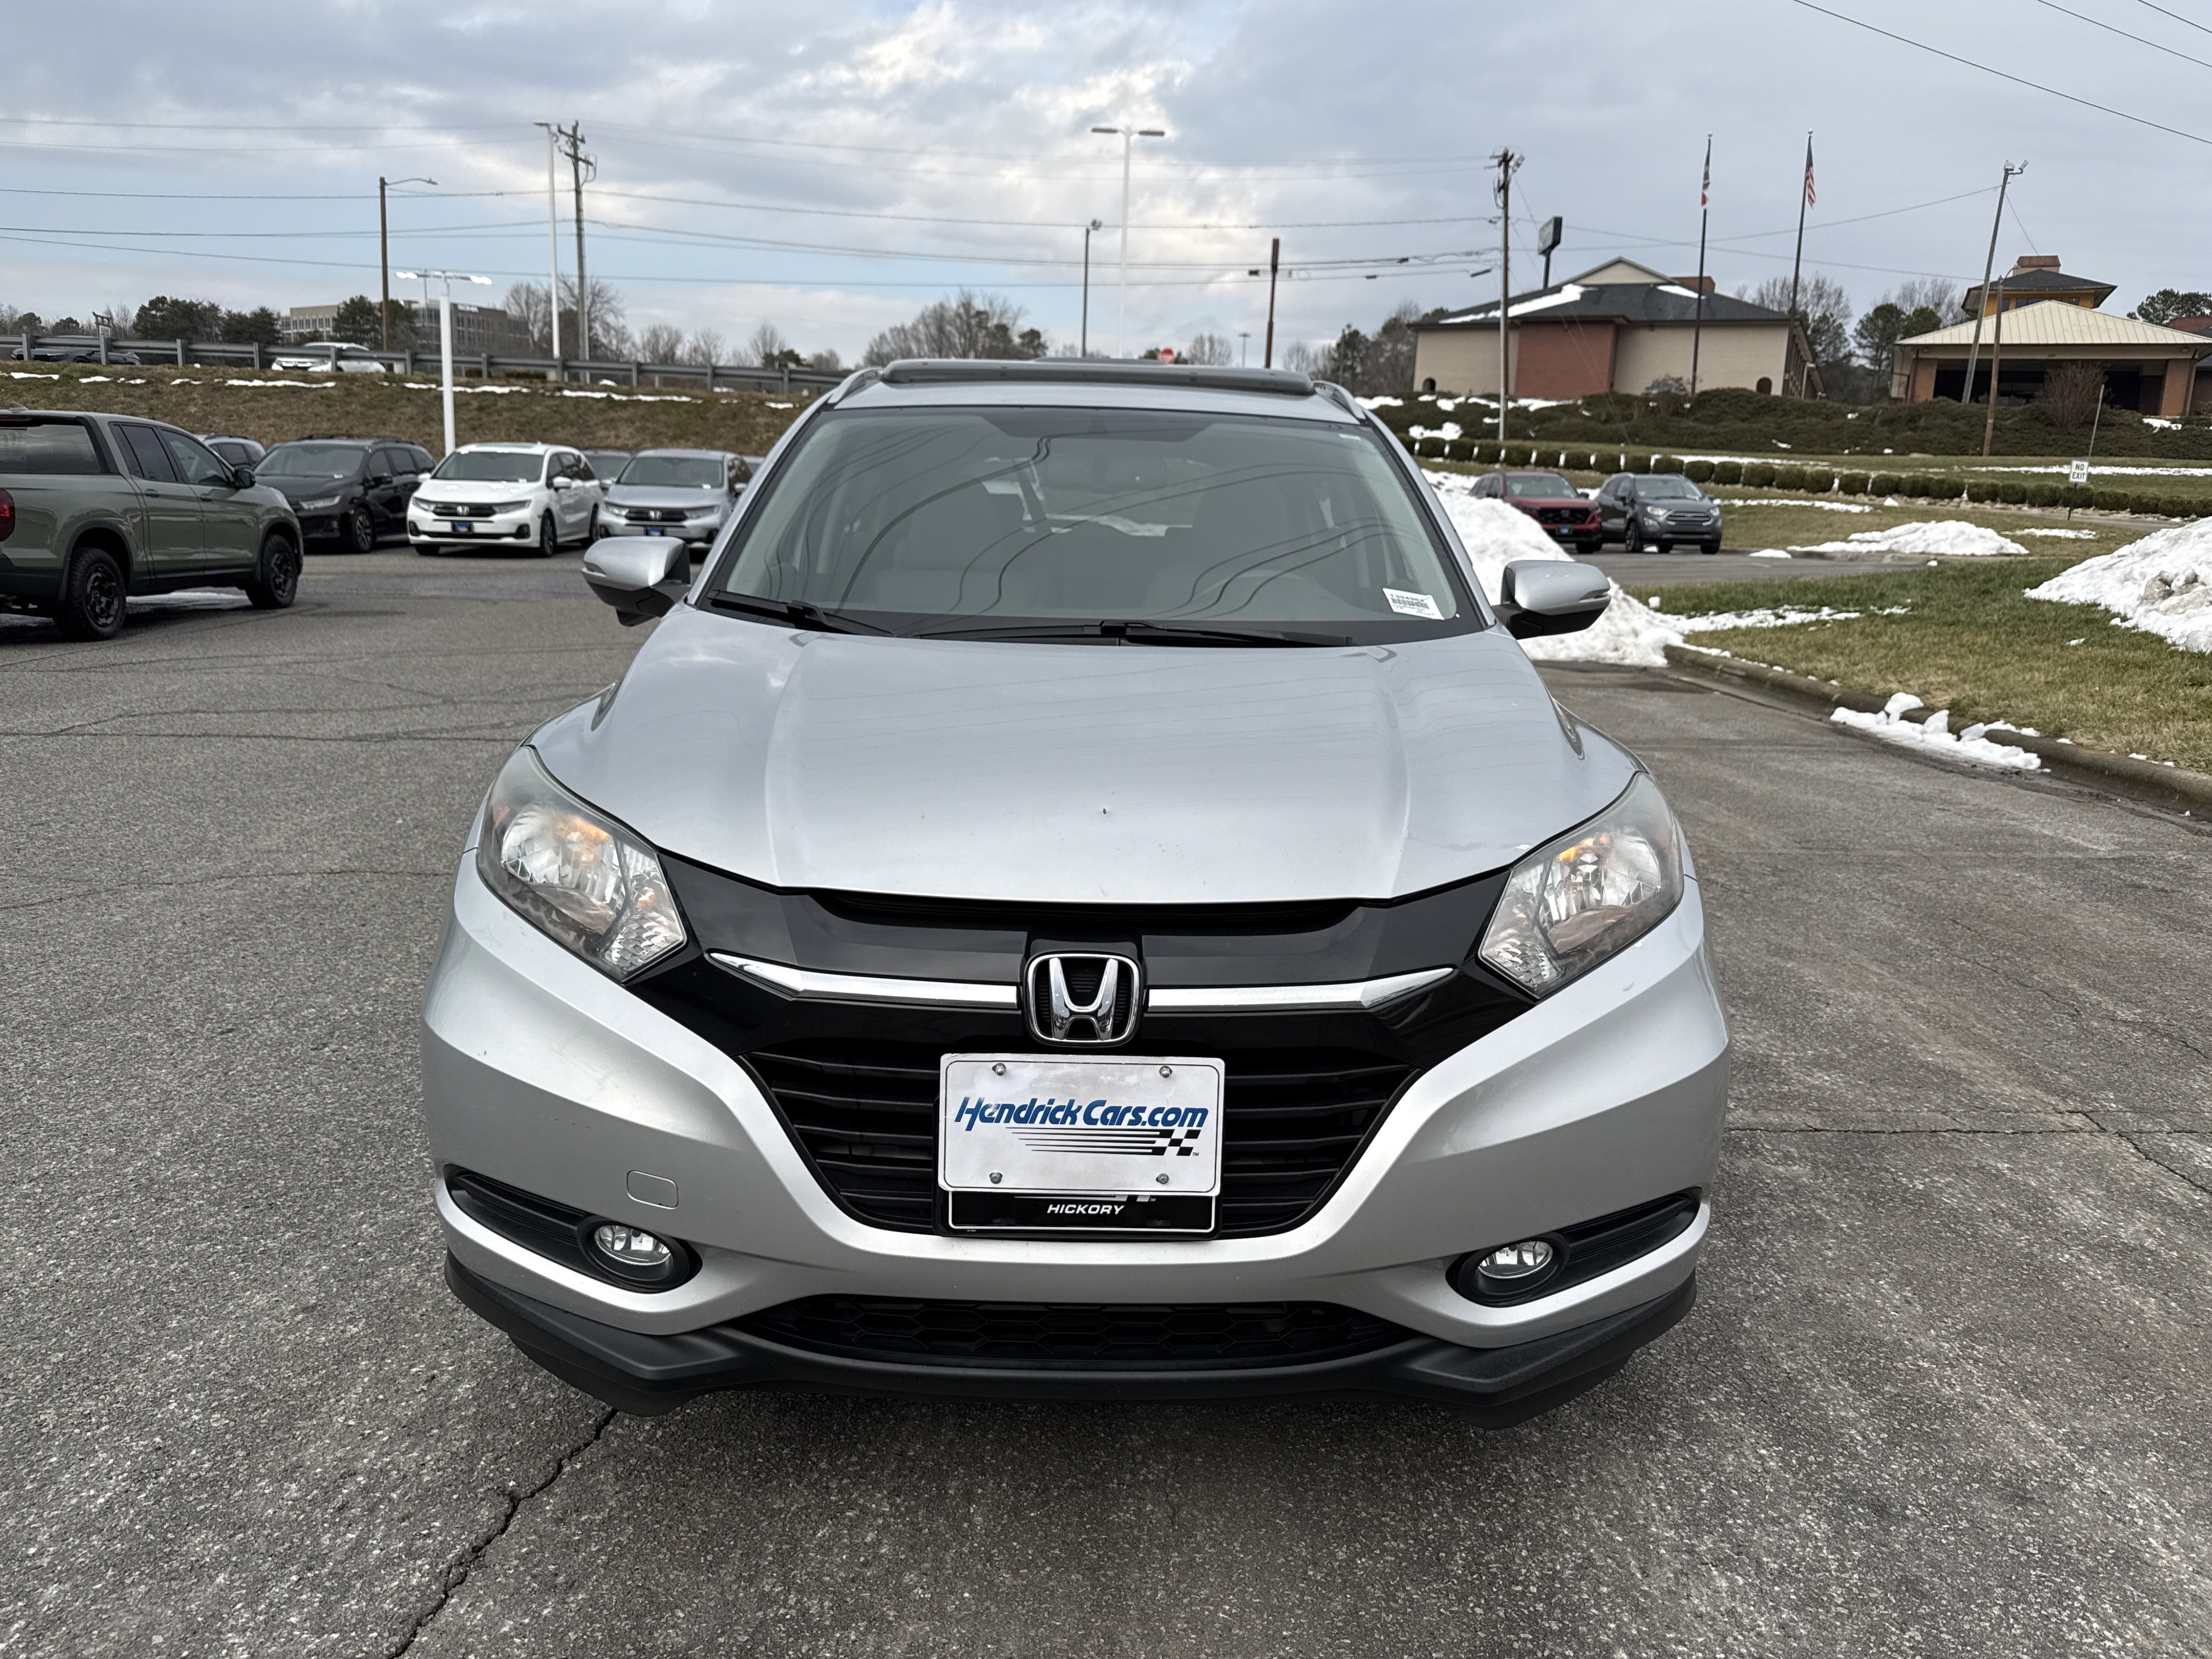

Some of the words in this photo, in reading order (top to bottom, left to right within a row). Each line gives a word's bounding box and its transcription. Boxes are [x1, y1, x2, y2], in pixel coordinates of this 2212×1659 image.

[954, 1096, 1083, 1131] Hendrick
[1082, 1099, 1209, 1127] Cars.com
[1047, 1204, 1125, 1215] HICKORY
